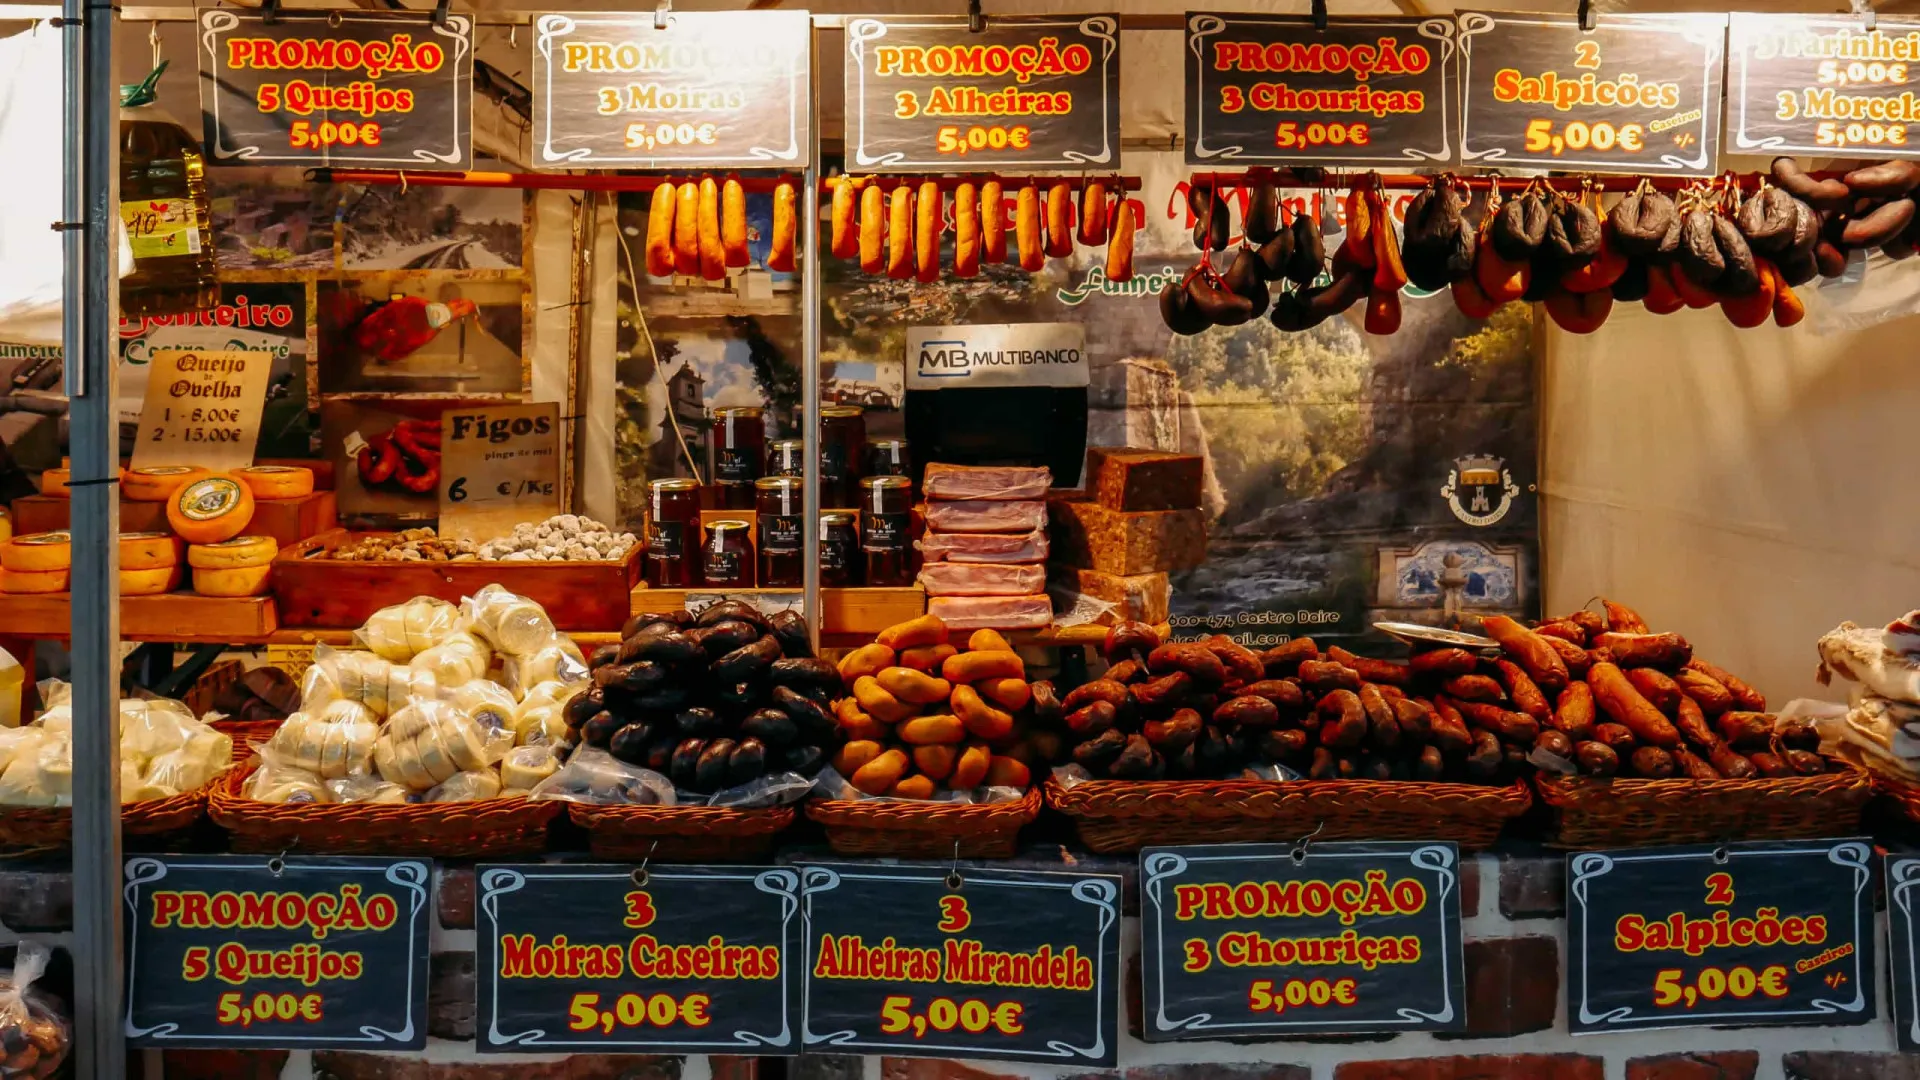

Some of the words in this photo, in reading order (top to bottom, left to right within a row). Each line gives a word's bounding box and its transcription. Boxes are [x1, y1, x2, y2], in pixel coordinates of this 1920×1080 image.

[227, 34, 443, 80] PROMOÇÃO
[875, 37, 1092, 83] PROMOÇÃO
[1214, 37, 1430, 80] PROMOÇÃO
[1573, 40, 1601, 70] 2
[1493, 69, 1680, 110] Salpicões
[1817, 60, 1909, 86] 5,00€
[257, 84, 278, 113] 5
[284, 81, 414, 115] Queijos
[597, 86, 621, 115] 3
[627, 83, 744, 111] Moiras
[895, 86, 918, 117] 3
[926, 86, 1071, 116] Alheiras
[1220, 85, 1244, 113] 3
[1248, 83, 1425, 116] Chouriças
[1776, 90, 1799, 121] 3
[289, 122, 381, 149] 5,00€
[625, 123, 718, 150] 5,00€
[1275, 122, 1370, 149] 5,00€
[1649, 108, 1702, 133] Caseiros
[1815, 122, 1907, 148] 5,00€
[935, 126, 1029, 153] 5,00€
[1524, 119, 1644, 156] 5,00€
[177, 353, 245, 373] Queijo
[919, 350, 969, 368] MB
[973, 349, 1079, 366] MULTIBANCO
[170, 380, 241, 400] Ovelha
[165, 408, 170, 422] 1
[451, 414, 551, 443] Figos
[152, 427, 164, 441] 2
[448, 477, 467, 502] 6
[1237, 611, 1295, 625] Castro
[1297, 609, 1340, 624] Daire
[1175, 873, 1426, 926] PROMOÇÃO
[1704, 872, 1734, 905] 2
[151, 886, 397, 939] PROMOÇÃO
[622, 891, 656, 928] 3
[937, 895, 970, 932] 3
[1615, 907, 1827, 956] Salpicões
[182, 945, 208, 979] 5
[215, 942, 362, 986] Queijos
[500, 934, 622, 979] Moiras
[627, 936, 780, 979] Caseiras
[814, 934, 939, 980] Alheiras
[944, 941, 1093, 991] Mirandela
[1183, 940, 1210, 972] 3
[1217, 930, 1421, 972] Chouriças
[1795, 942, 1854, 974] Caseiros
[1248, 979, 1357, 1013] 5,00€
[1654, 965, 1789, 1009] 5,00€
[1824, 972, 1847, 990] +/-
[217, 992, 323, 1025] 5,00€
[567, 992, 711, 1033] 5,00€
[879, 996, 1023, 1037] 5,00€
